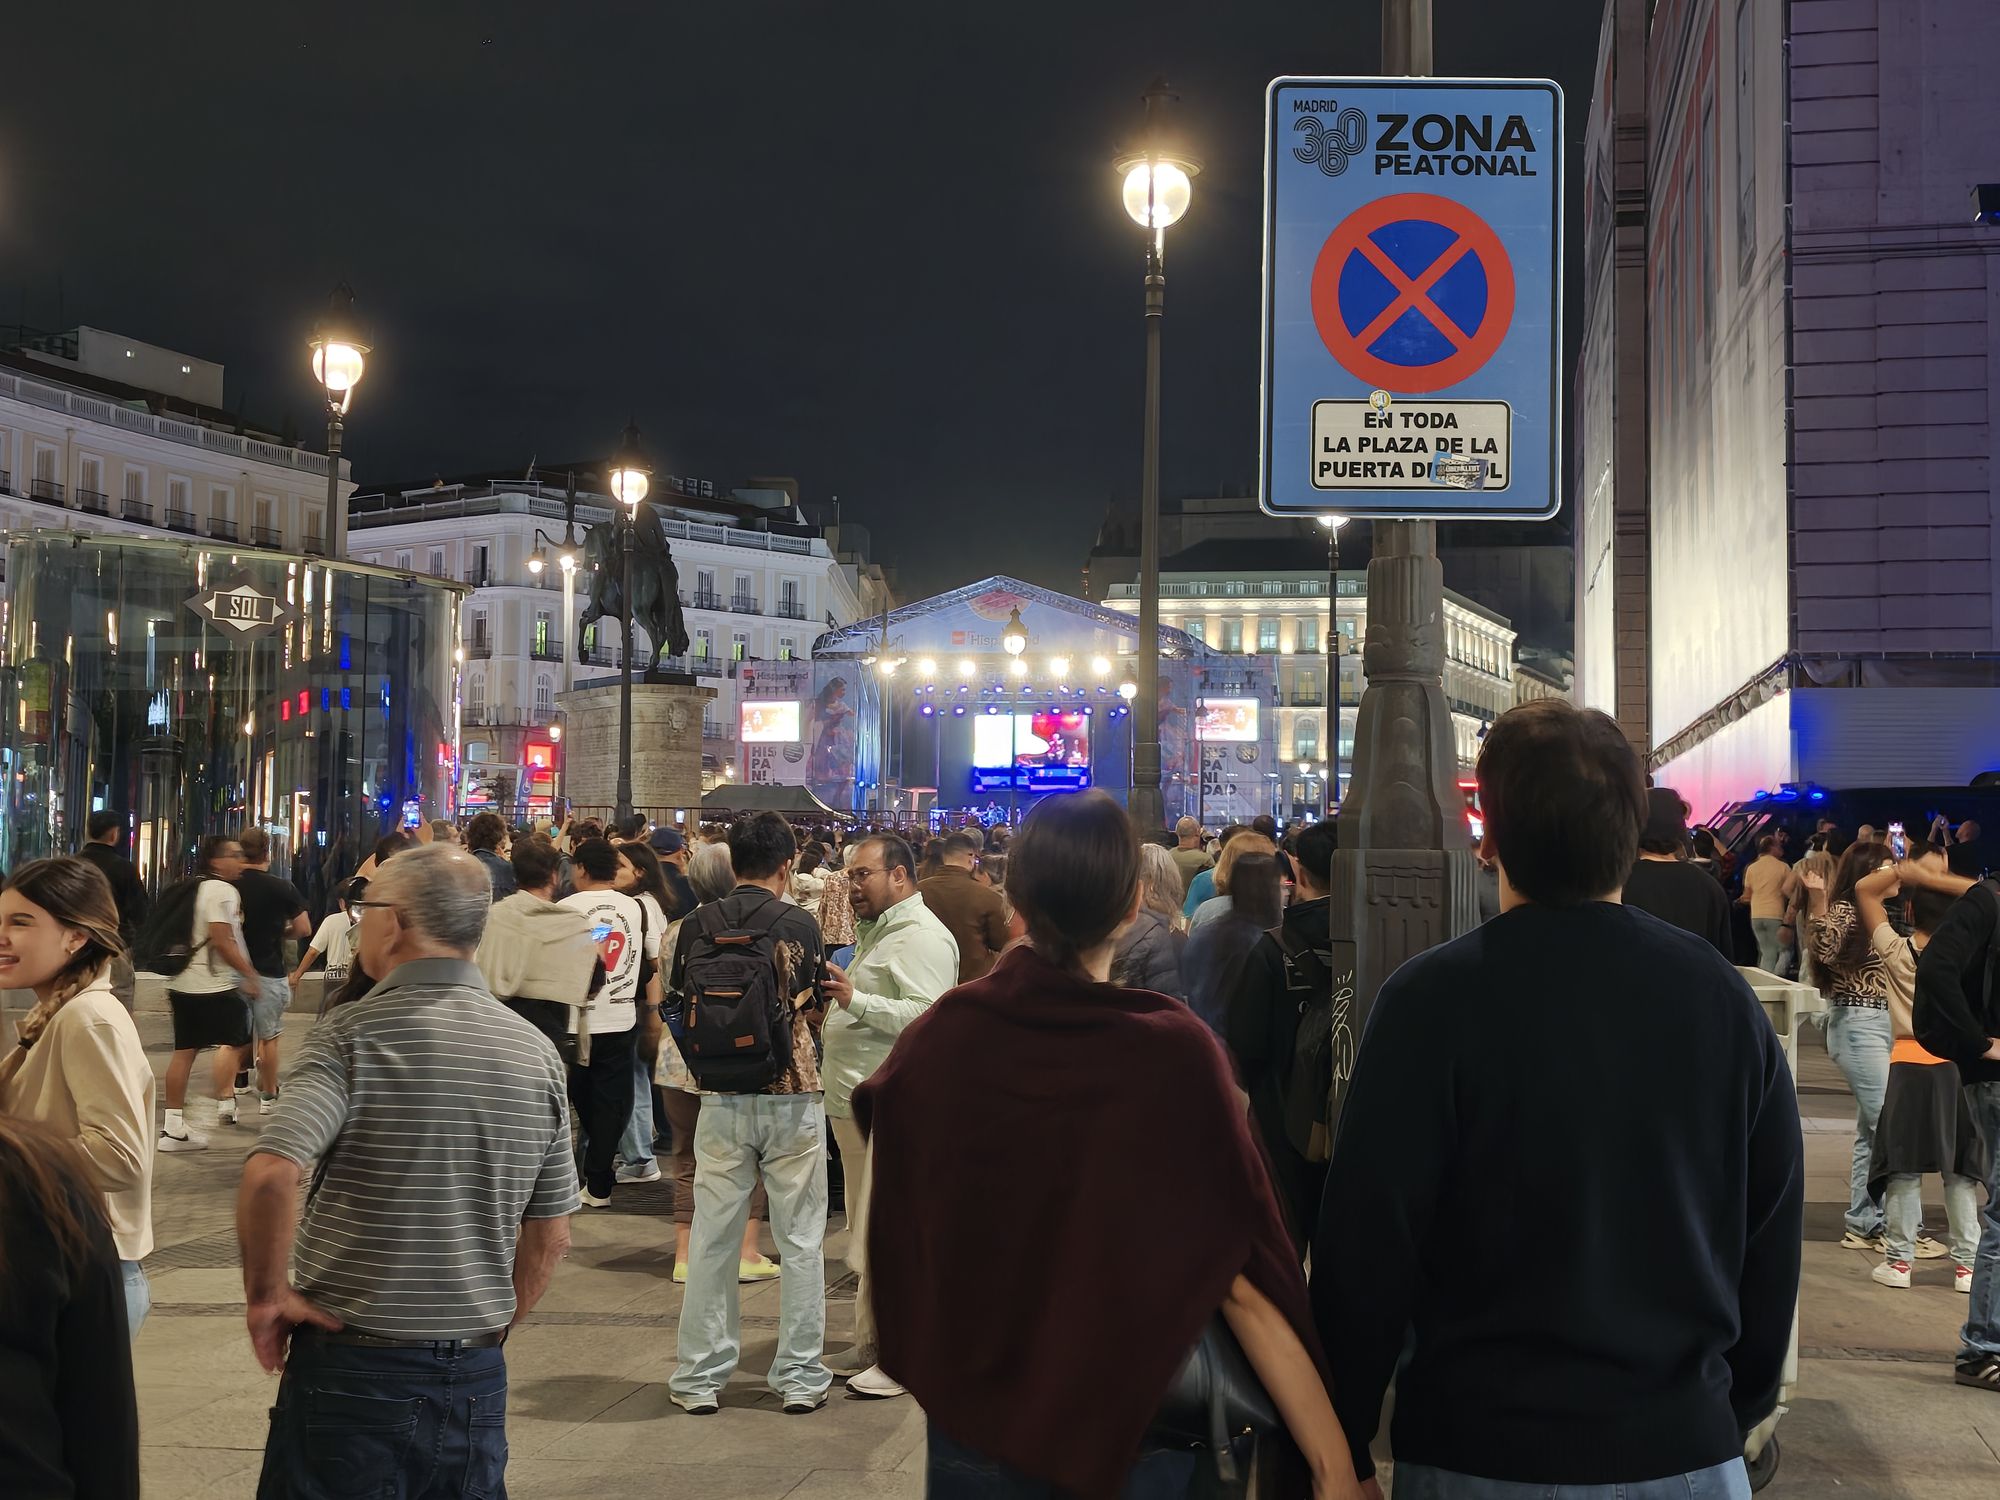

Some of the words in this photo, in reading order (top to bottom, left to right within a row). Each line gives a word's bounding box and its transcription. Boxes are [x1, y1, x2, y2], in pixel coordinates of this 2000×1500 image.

[1293, 100, 1338, 113] MADRID
[1376, 114, 1537, 152] ZONA
[1293, 107, 1368, 177] 360
[1375, 154, 1537, 177] PEATONAL
[1364, 412, 1393, 429] EN
[1400, 412, 1459, 429] TODA
[1323, 437, 1351, 453] LA
[1358, 437, 1429, 454] PLAZA
[1436, 437, 1463, 454] DE
[1471, 438, 1498, 454] LA
[1319, 462, 1405, 478] PUERTA
[230, 596, 260, 619] SOL
[752, 759, 771, 769] PA
